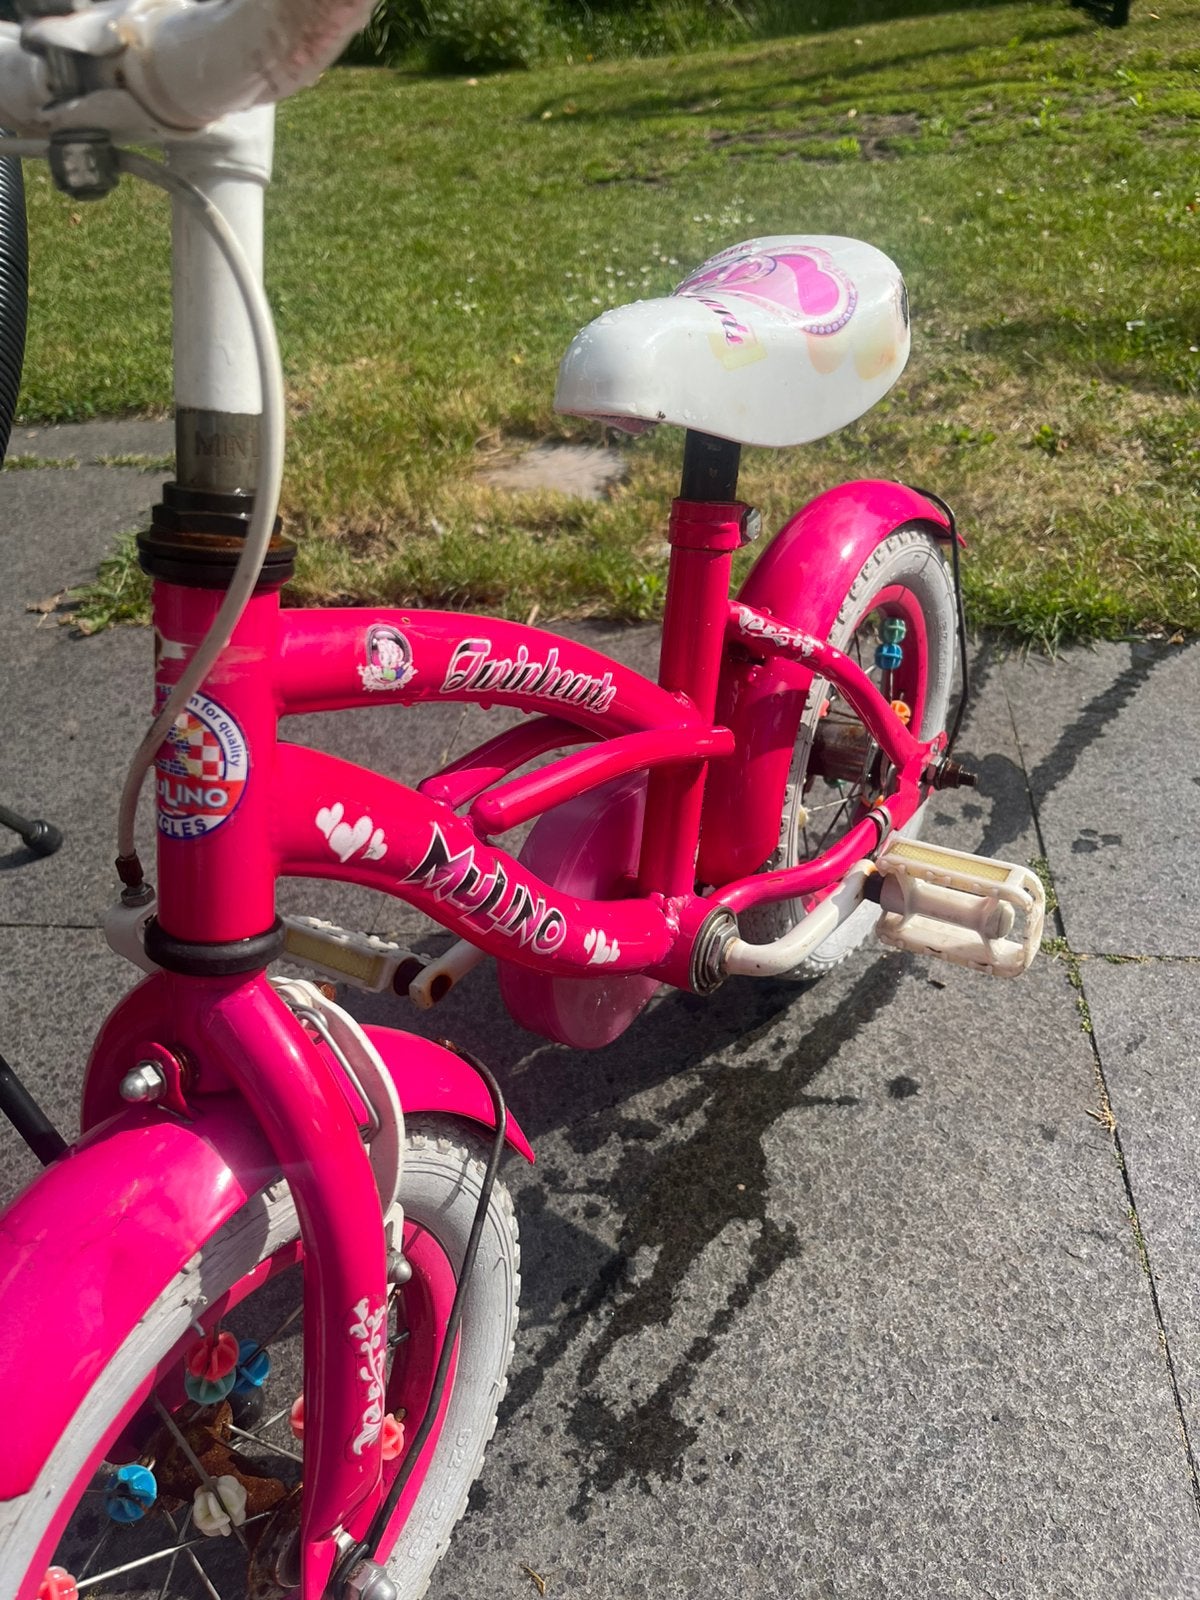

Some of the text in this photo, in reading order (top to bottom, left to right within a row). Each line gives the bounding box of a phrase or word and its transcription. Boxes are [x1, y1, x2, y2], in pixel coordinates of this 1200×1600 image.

[201, 702, 242, 767] for quality
[157, 777, 229, 809] ULINO
[160, 816, 207, 837] CLES
[396, 820, 567, 955] MULINO
